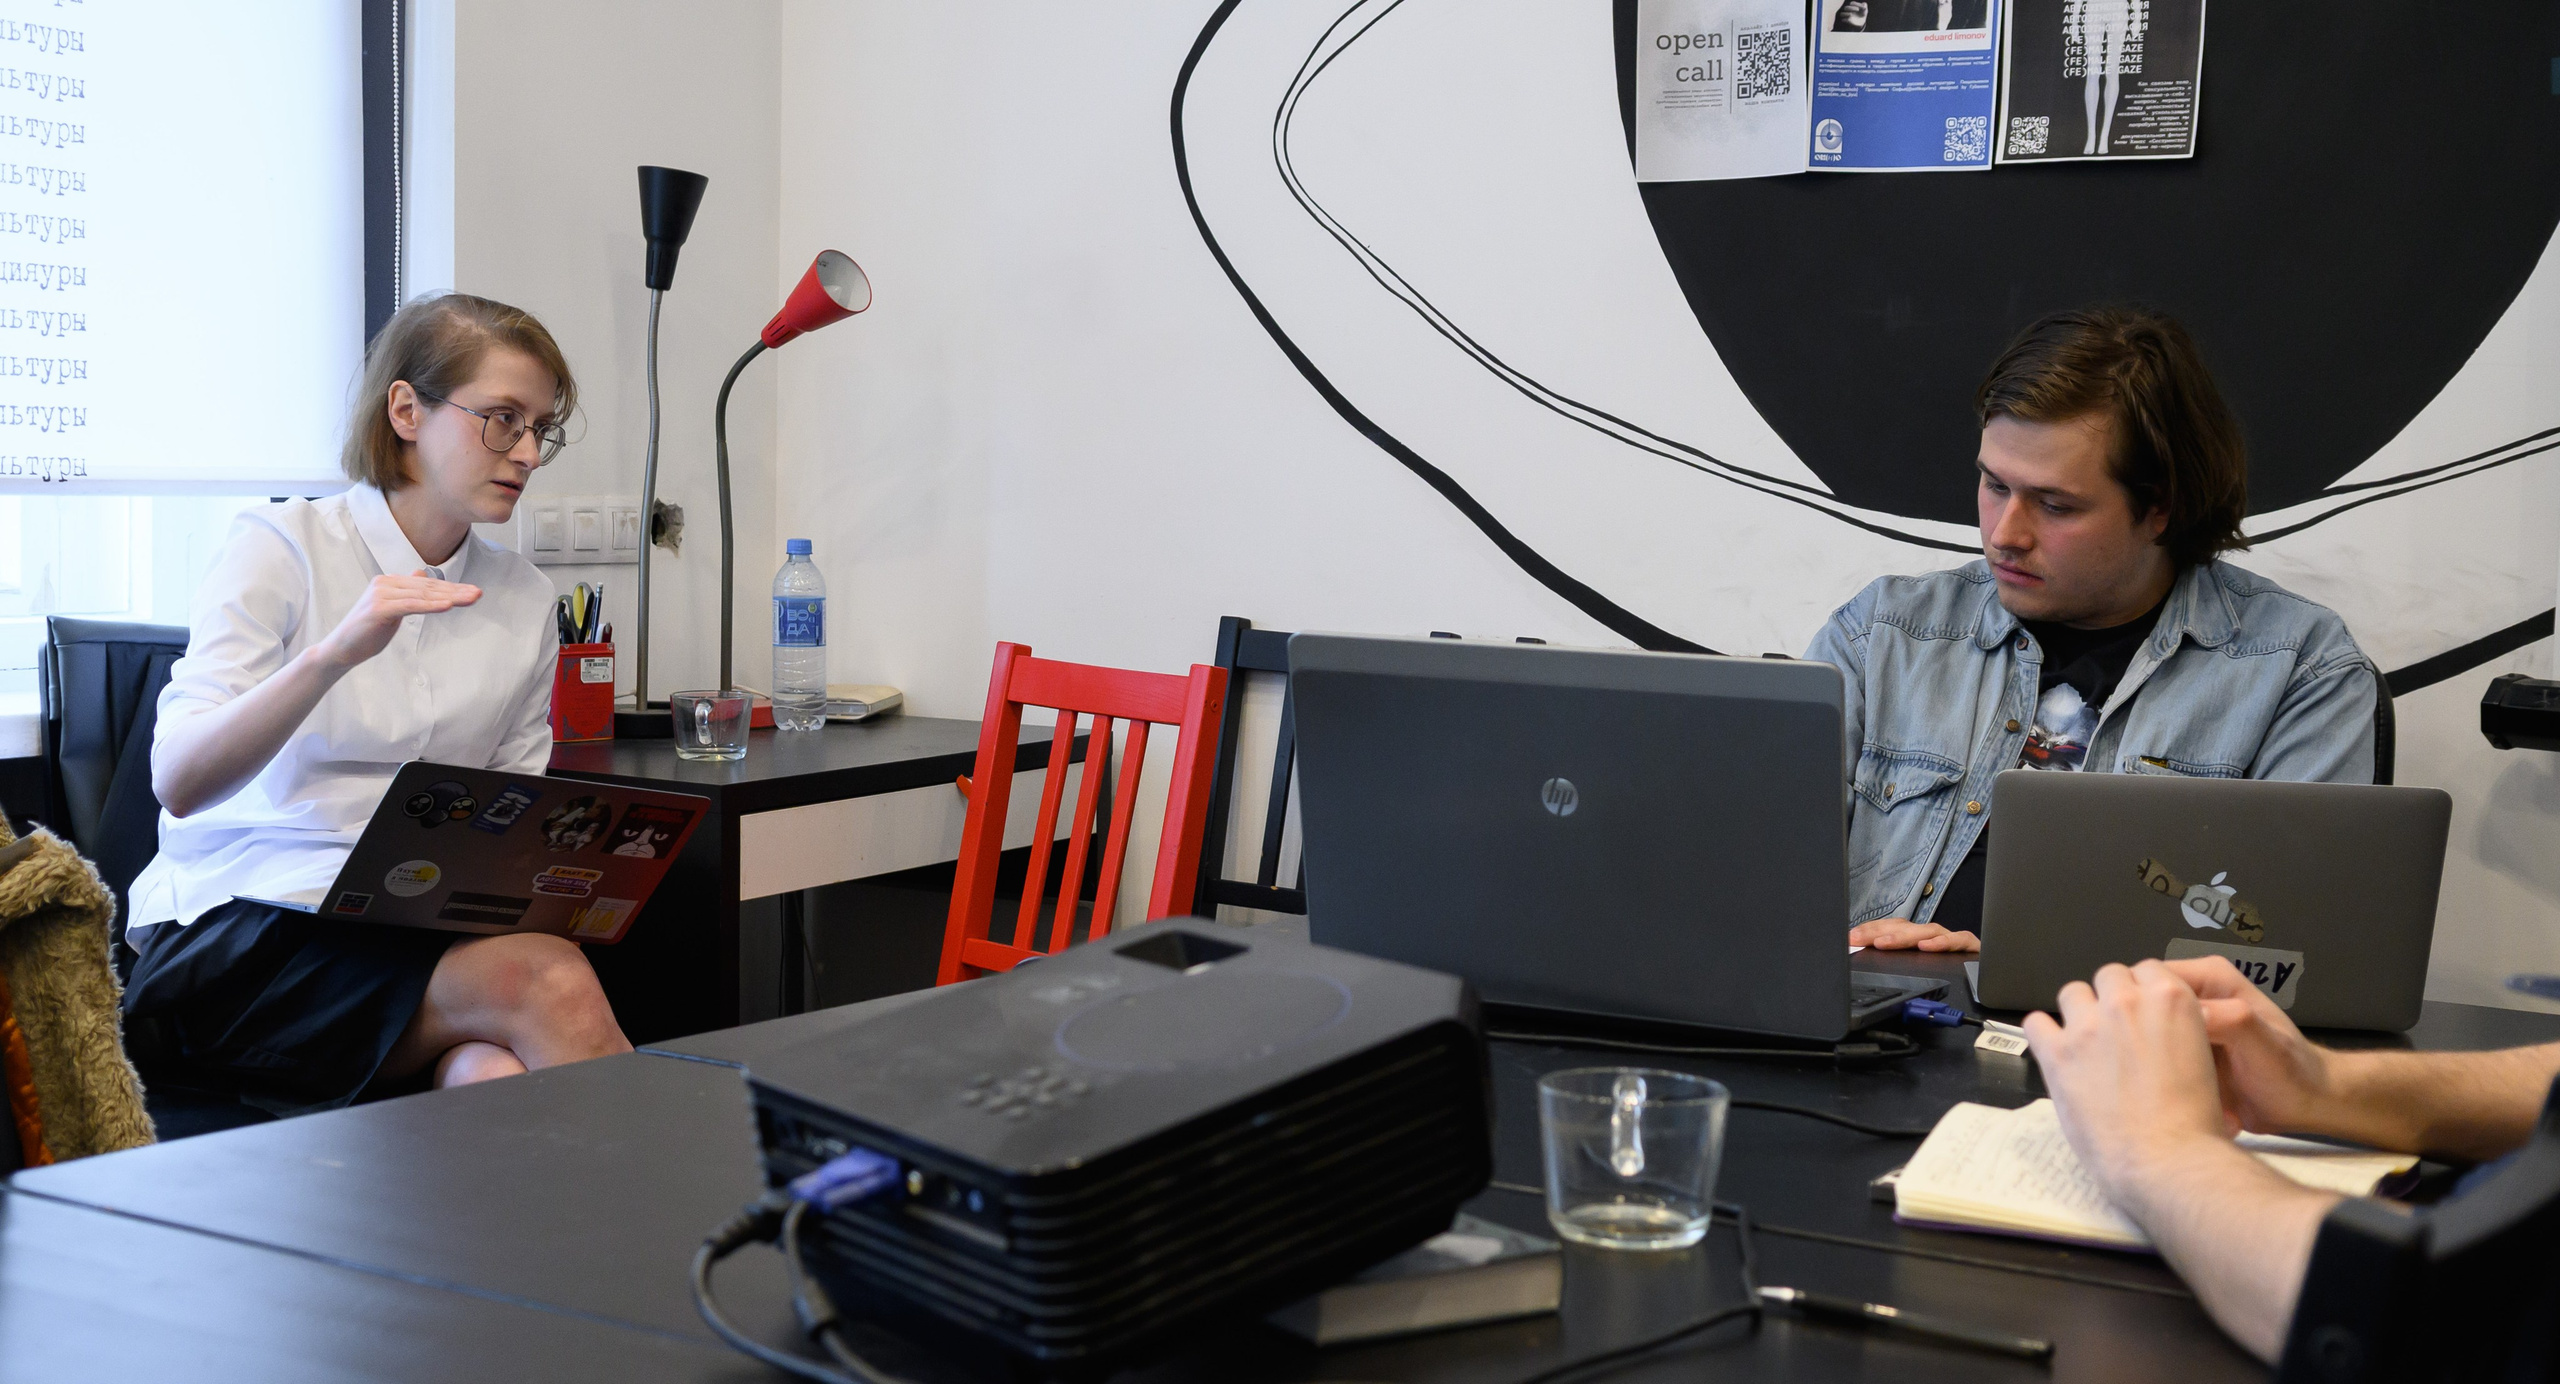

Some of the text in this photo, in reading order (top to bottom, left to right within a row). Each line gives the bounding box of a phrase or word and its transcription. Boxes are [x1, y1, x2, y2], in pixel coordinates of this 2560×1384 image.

[1924, 32, 1986, 41] eduard limonov
[1656, 32, 1724, 55] open
[2120, 44, 2144, 52] GAZE
[2119, 54, 2143, 63] GAZE
[1676, 60, 1723, 82] call
[2118, 65, 2142, 74] GAZE
[787, 609, 809, 621] ВО
[786, 623, 810, 636] ДА
[1543, 778, 1578, 816] hp
